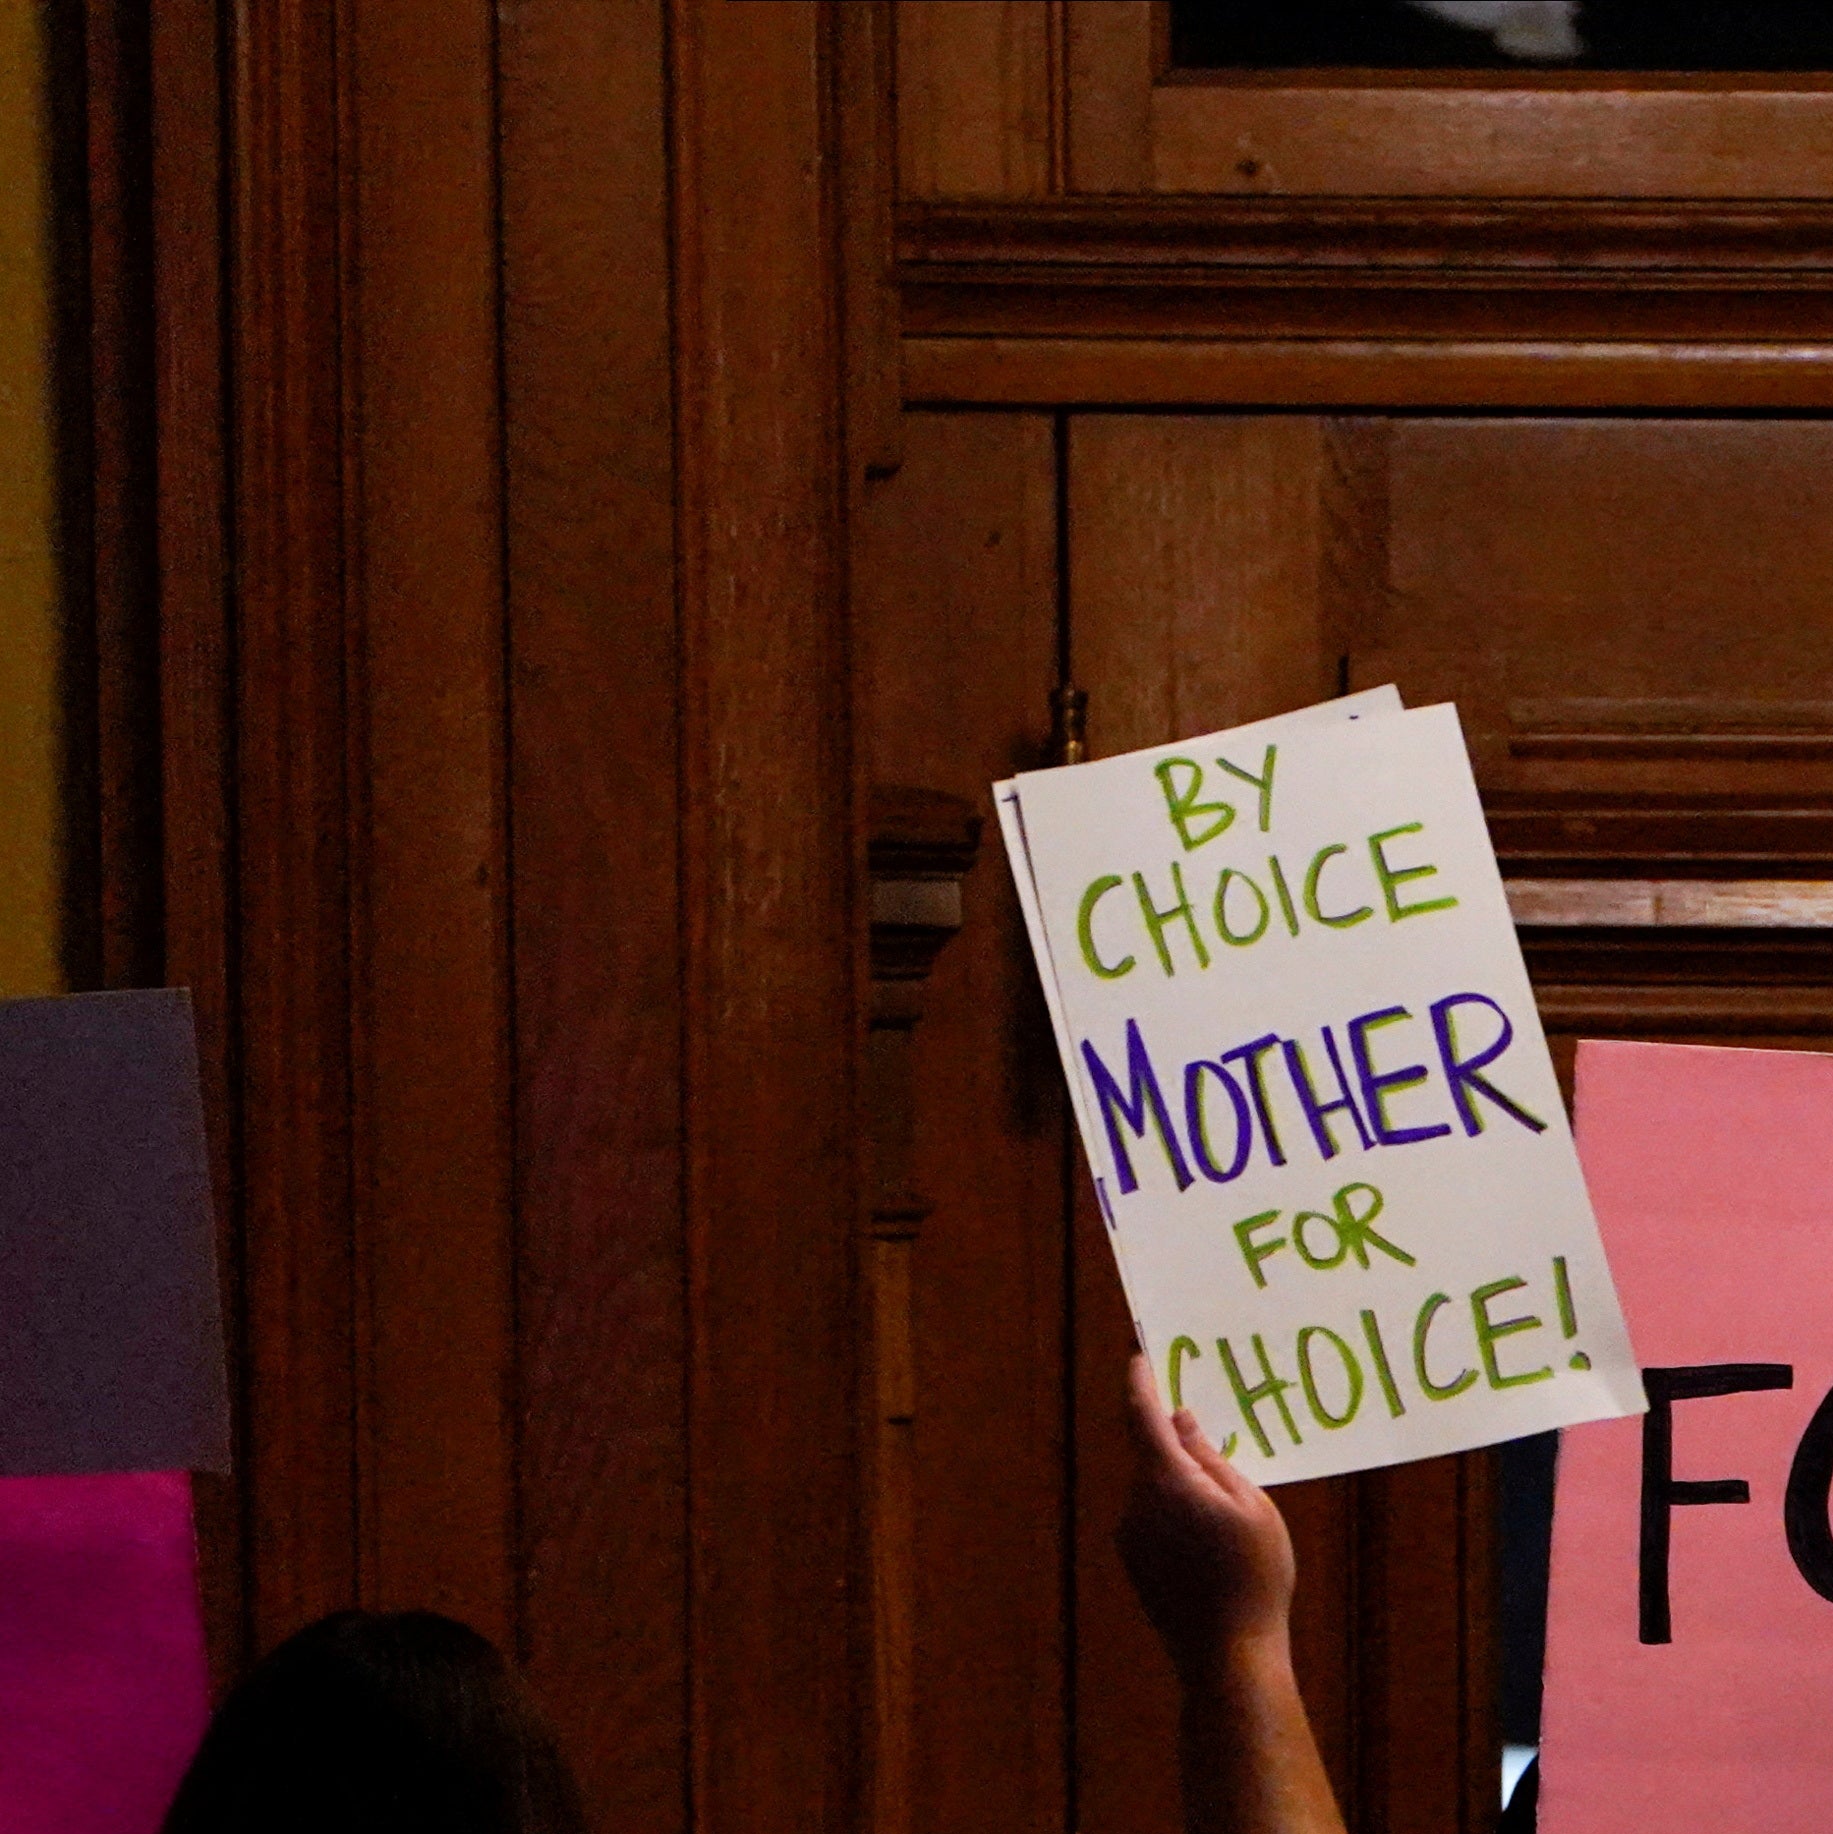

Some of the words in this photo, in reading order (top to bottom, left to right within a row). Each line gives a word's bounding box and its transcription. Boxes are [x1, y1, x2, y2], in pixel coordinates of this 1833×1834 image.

[1154, 744, 1278, 852] BY
[1078, 822, 1459, 979] CHOICE
[1082, 992, 1548, 1196] MOTHER
[1233, 1182, 1416, 1289] FOR
[1169, 1256, 1591, 1459] CHOICE!
